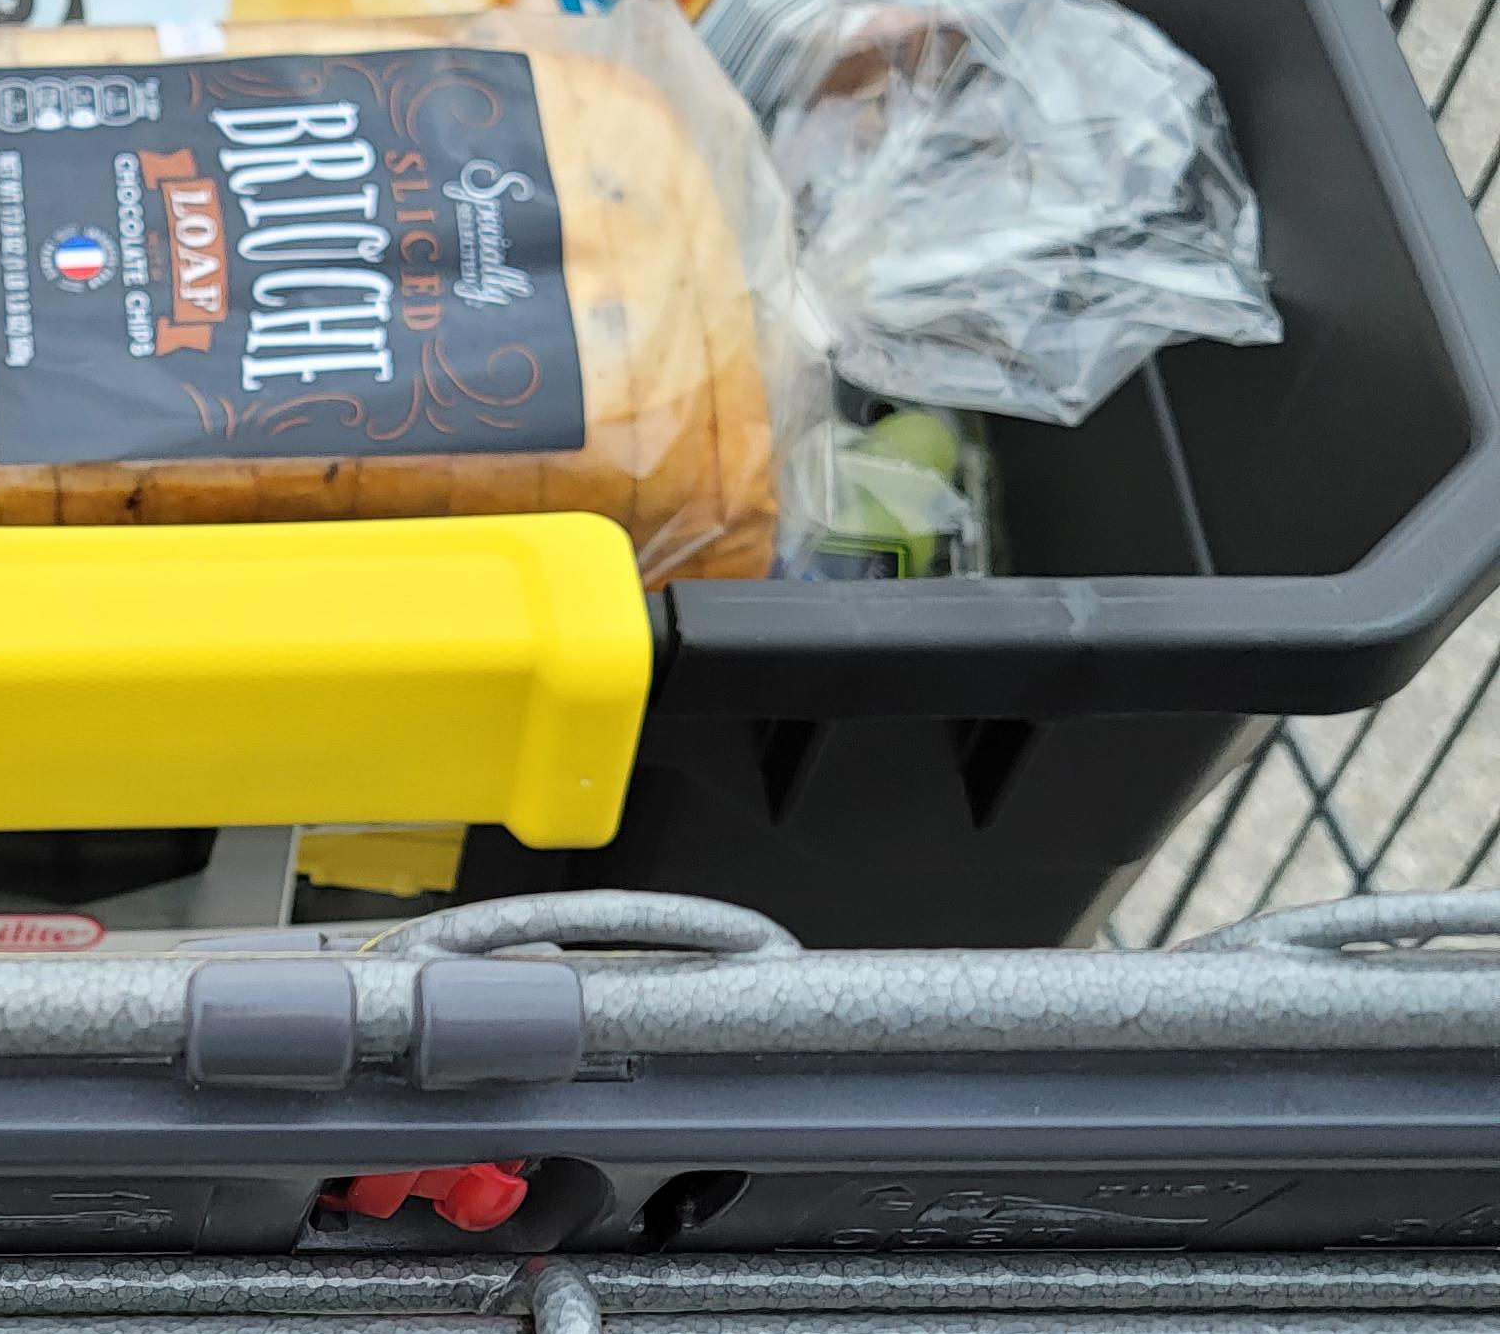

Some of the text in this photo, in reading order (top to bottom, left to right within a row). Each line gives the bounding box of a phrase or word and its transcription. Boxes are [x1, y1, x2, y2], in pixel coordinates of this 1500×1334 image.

[114, 151, 156, 358] CHOCOLATE CHIPS
[169, 186, 223, 315] LOAF
[208, 99, 395, 393] BRIOCHE
[384, 149, 443, 332] SLICED
